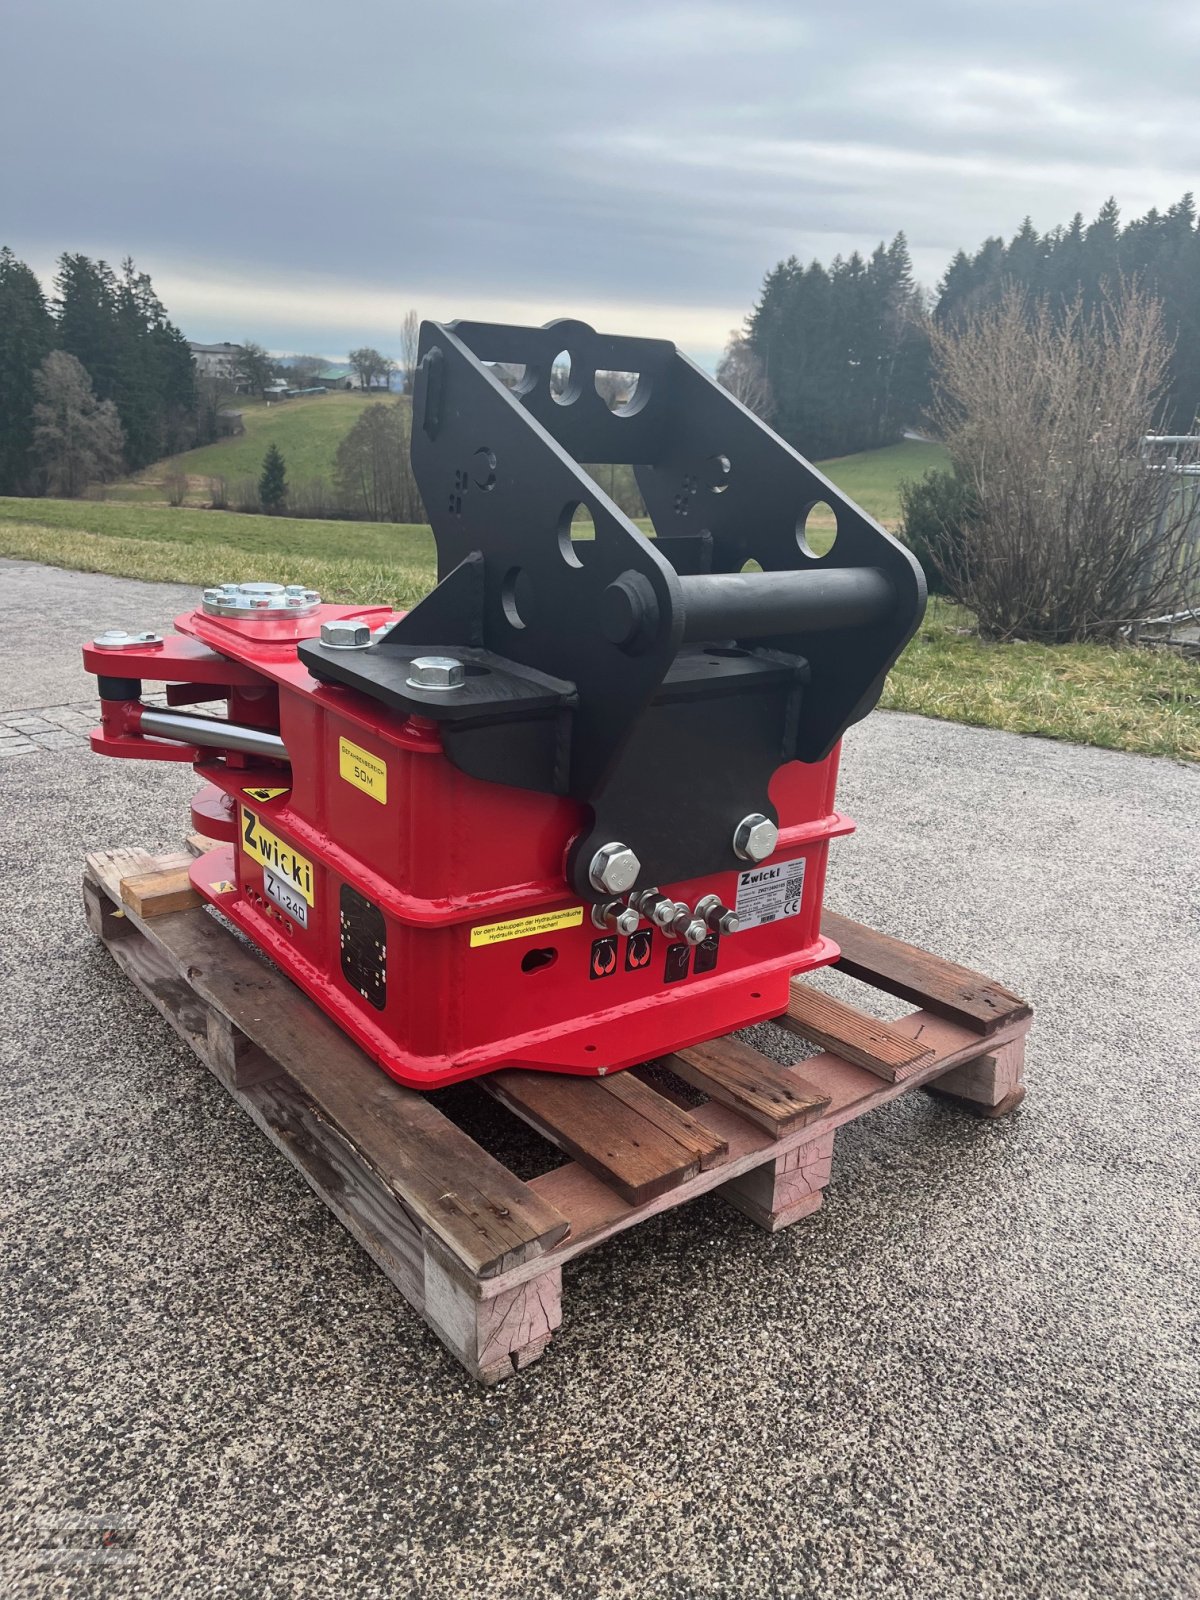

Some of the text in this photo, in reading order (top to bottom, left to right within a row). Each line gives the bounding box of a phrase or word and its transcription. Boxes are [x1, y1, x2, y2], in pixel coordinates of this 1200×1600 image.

[244, 808, 310, 892] Zwicki
[741, 868, 780, 885] Zwicki
[267, 874, 305, 921] Z1-240
[484, 927, 496, 935] dem
[496, 922, 524, 932] Abkuppeln
[489, 931, 513, 940] Hydraulik
[537, 921, 558, 930] machen!
